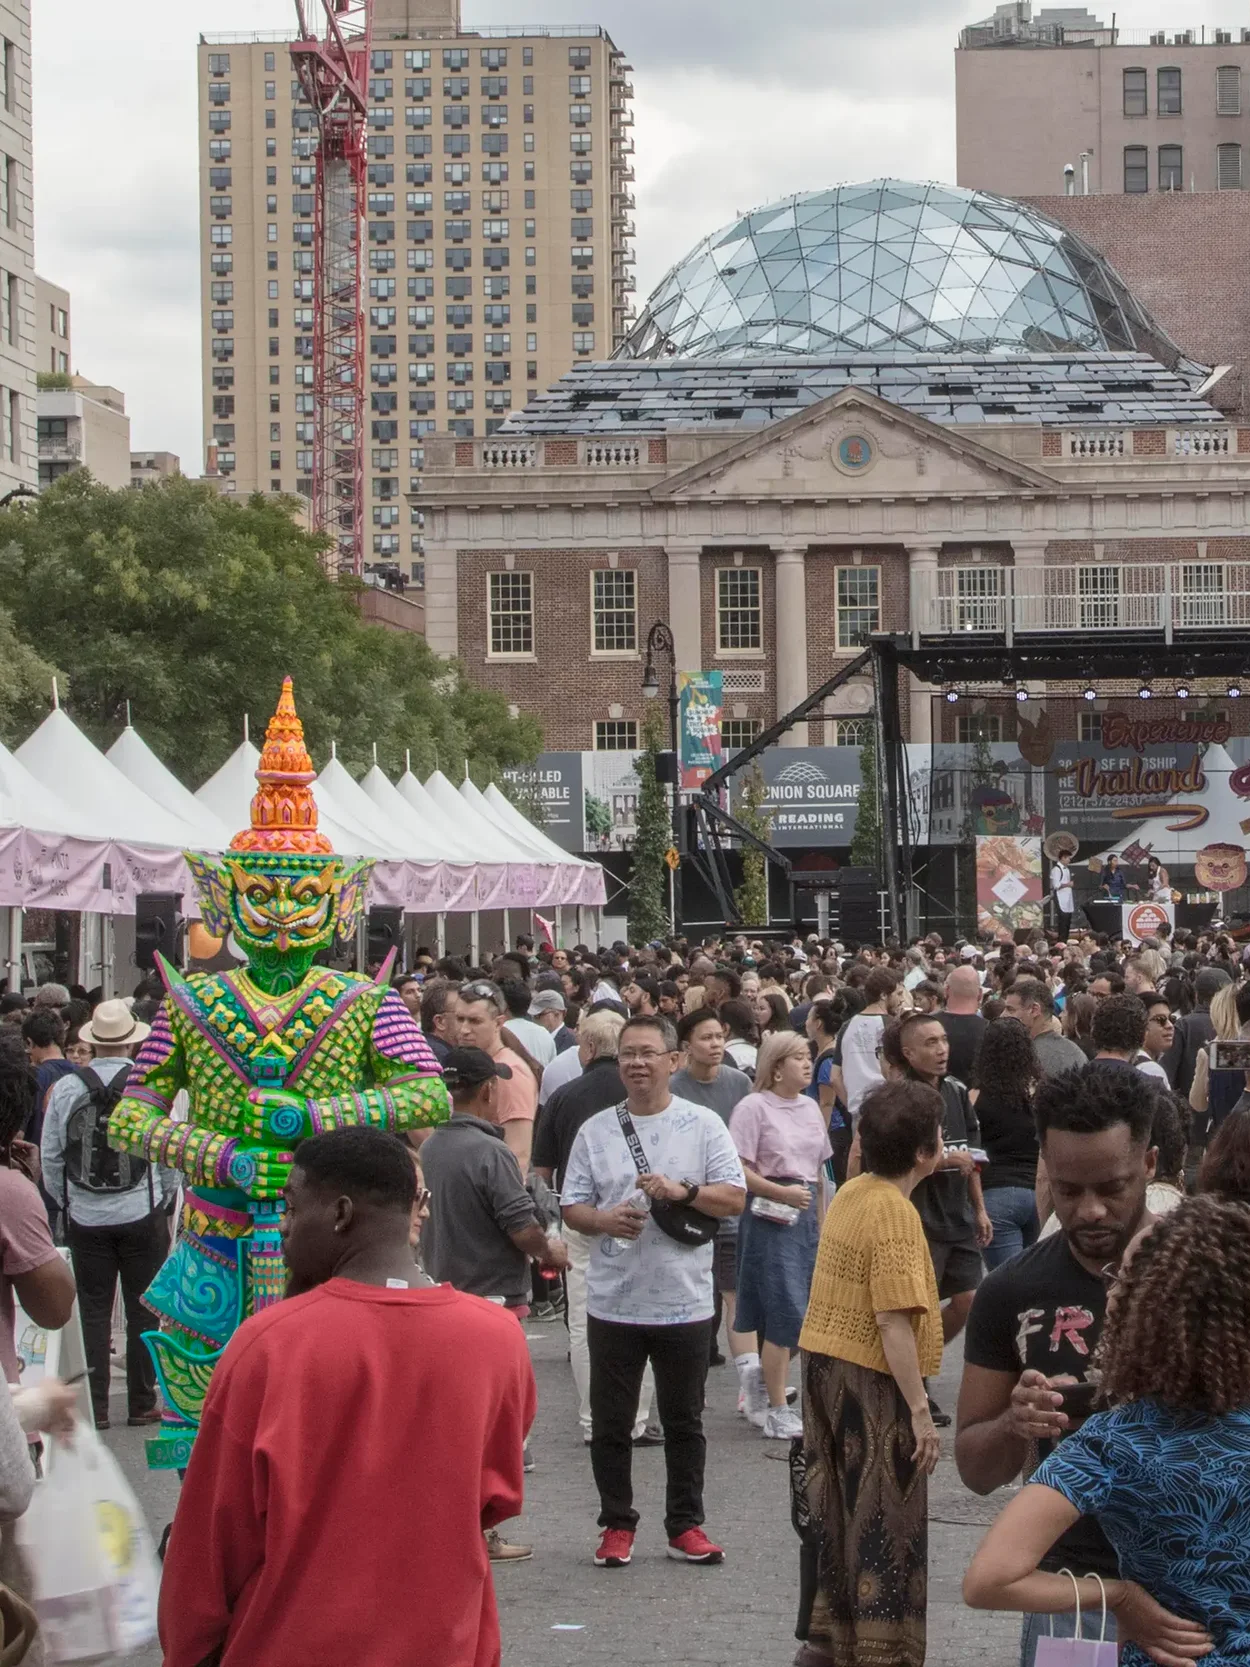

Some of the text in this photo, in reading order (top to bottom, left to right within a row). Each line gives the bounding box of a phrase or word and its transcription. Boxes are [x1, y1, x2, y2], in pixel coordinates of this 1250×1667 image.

[1103, 711, 1231, 752] Experience
[1119, 756, 1177, 770] FLGSHIP
[1054, 754, 1206, 798] Thailand
[807, 783, 860, 799] SQUARE
[778, 813, 845, 824] READING
